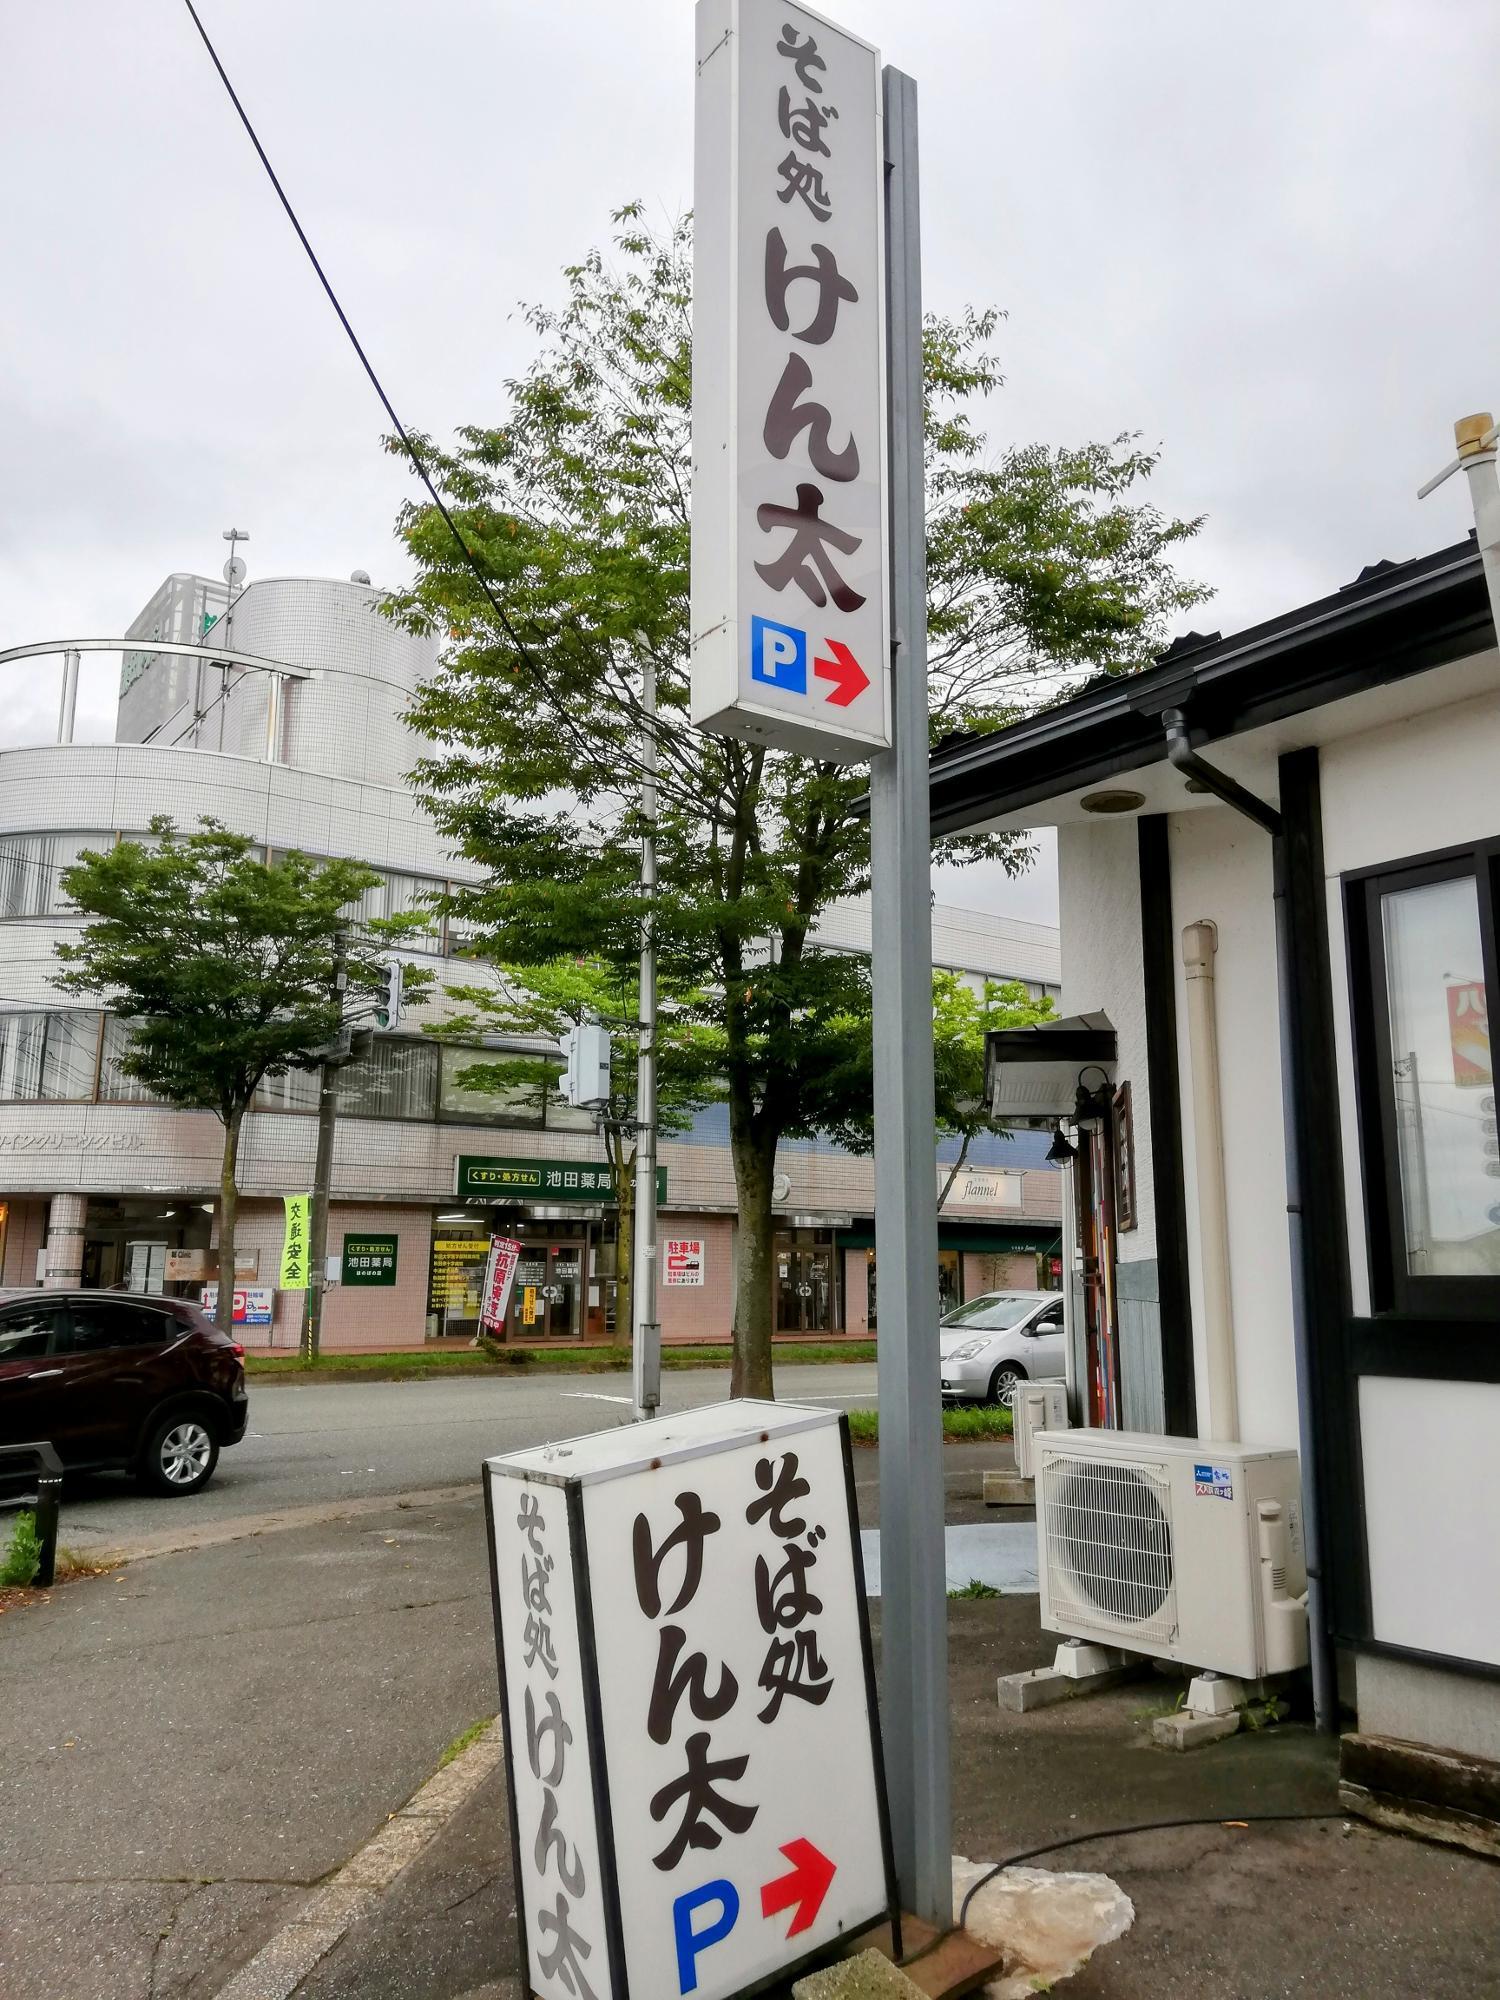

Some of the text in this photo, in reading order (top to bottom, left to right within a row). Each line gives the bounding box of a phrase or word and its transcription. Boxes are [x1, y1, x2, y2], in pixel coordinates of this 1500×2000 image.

[753, 23, 867, 613] そば処 けん太
[763, 627, 797, 678] P
[472, 1171, 537, 1183] くすり・処方せん
[546, 1171, 611, 1189] 池田薬局
[962, 1181, 999, 1199] flannel
[348, 1257, 393, 1268] 池田薬局
[668, 1241, 700, 1254] 駐車場
[745, 1452, 834, 1724] そば処
[632, 1491, 760, 1871] けん太
[516, 1493, 600, 2000] そば処 けん太
[673, 1878, 739, 1995] P
